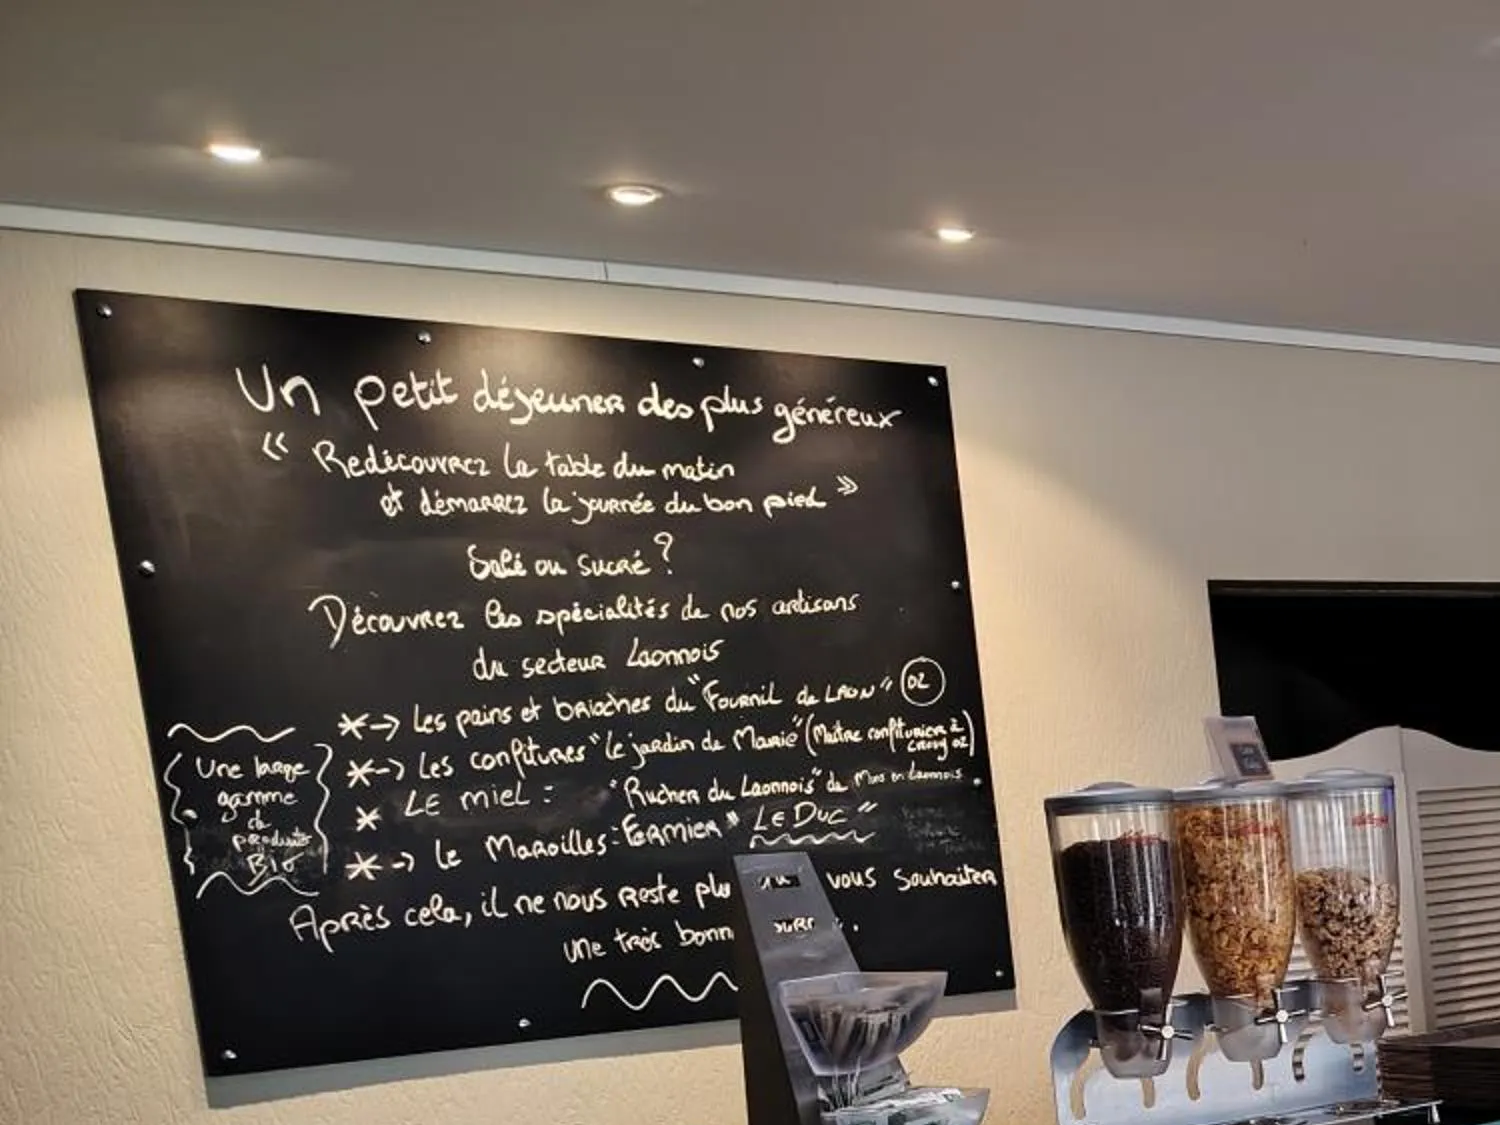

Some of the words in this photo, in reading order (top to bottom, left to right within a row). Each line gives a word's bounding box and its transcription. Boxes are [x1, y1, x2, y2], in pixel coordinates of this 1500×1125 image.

[235, 364, 321, 416] Un
[354, 369, 459, 431] petit
[473, 368, 625, 425] déjeuner
[637, 381, 694, 420] des
[701, 384, 764, 432] plus
[772, 395, 902, 444] généreux
[545, 450, 605, 479] table
[613, 451, 655, 478] du
[662, 455, 735, 482] matin
[380, 482, 405, 518] et
[420, 486, 529, 516] démarrez
[543, 486, 571, 515] la
[572, 490, 654, 524] journée
[664, 490, 702, 514] du
[703, 492, 754, 512] bon
[763, 485, 827, 519] pied
[467, 543, 527, 581] Salé
[535, 557, 567, 577] ou
[308, 594, 465, 650] Découvrez
[536, 594, 671, 636] spécialités
[681, 592, 710, 621] de
[720, 599, 759, 623] nos
[771, 588, 861, 616] artisans
[473, 646, 508, 680] du
[521, 647, 607, 678] secteur
[626, 637, 726, 667] Laonnois
[456, 704, 513, 738] pains
[521, 696, 542, 723] et
[552, 691, 652, 722] brioches
[665, 686, 697, 712] du
[796, 685, 820, 706] de
[907, 672, 930, 690] 02
[196, 755, 245, 779] Une
[254, 755, 311, 783] large
[420, 751, 454, 779] Les
[470, 736, 586, 779] confitures
[628, 731, 695, 770] jardin
[701, 730, 726, 752] de
[707, 777, 737, 803] du
[826, 770, 848, 793] de
[217, 789, 299, 824] gamme
[247, 808, 273, 830] de
[232, 826, 313, 853] produits
[289, 904, 393, 953] Après
[403, 893, 473, 928] cela,
[480, 886, 509, 918] il
[514, 895, 547, 915] ne
[553, 887, 609, 913] nous
[619, 873, 681, 909] reste
[695, 873, 732, 910] plu
[614, 928, 662, 953] très
[675, 916, 735, 949] bonn
